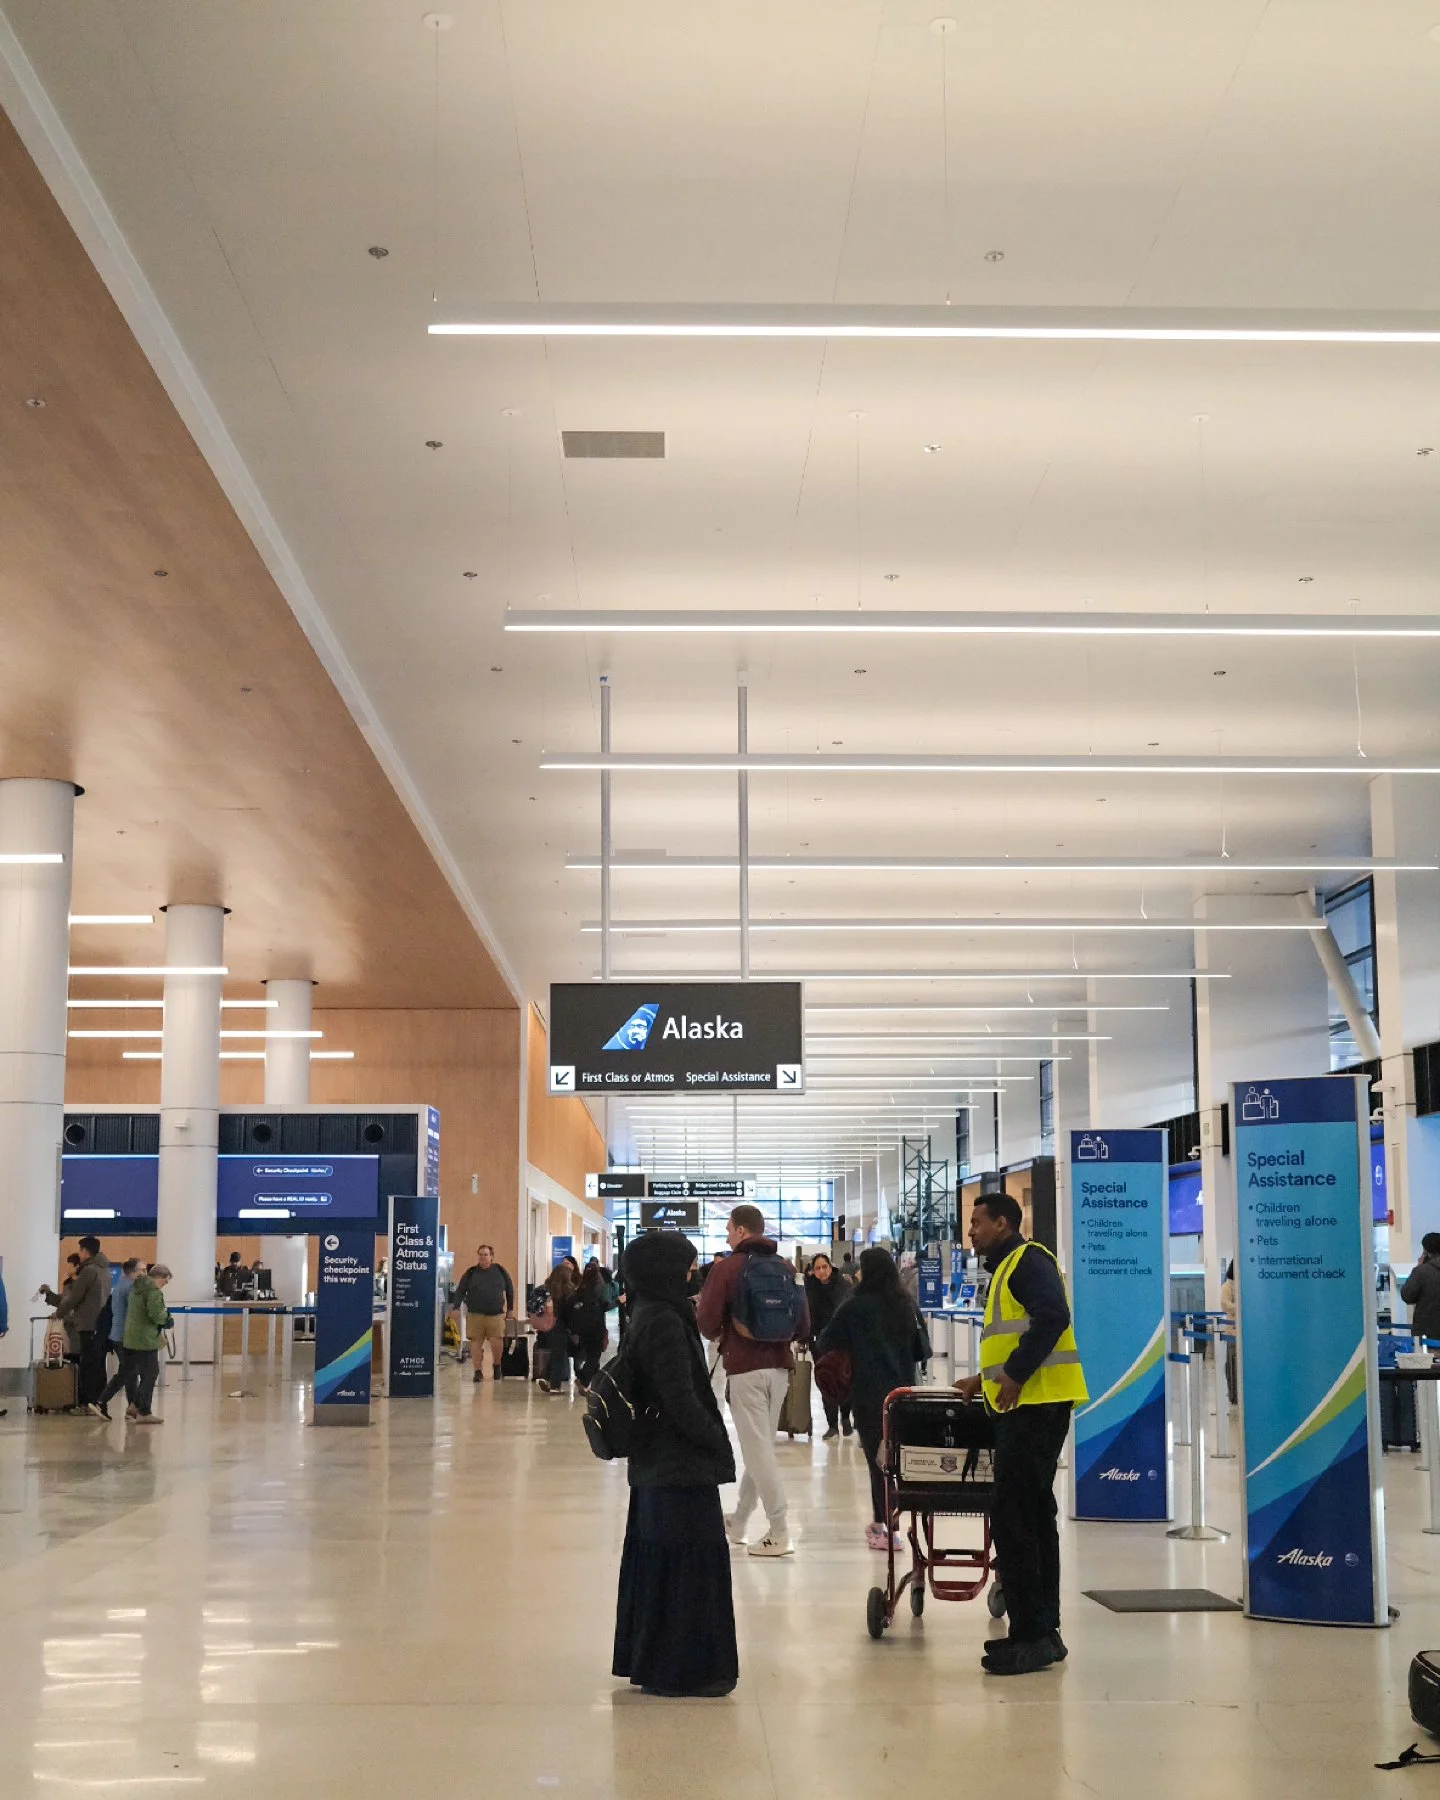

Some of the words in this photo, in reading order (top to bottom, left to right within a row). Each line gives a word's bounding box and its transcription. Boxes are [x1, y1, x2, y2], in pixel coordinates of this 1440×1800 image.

[662, 1015, 743, 1039] Alaska
[582, 1072, 602, 1083] First
[605, 1072, 629, 1083] Class
[631, 1074, 642, 1083] or
[643, 1072, 675, 1083] Atmos
[686, 1072, 719, 1084] Special
[721, 1071, 771, 1082] Assistance
[1247, 1150, 1305, 1170] Special
[1248, 1172, 1337, 1188] Assistance
[1081, 1181, 1127, 1195] Special
[1081, 1196, 1149, 1208] Assistance
[1255, 1202, 1301, 1213] Children
[666, 1209, 687, 1217] Alaska
[1087, 1219, 1123, 1228] Children
[1255, 1215, 1301, 1228] traveling
[1304, 1215, 1338, 1226] alone
[397, 1223, 420, 1234] First
[1087, 1228, 1123, 1239] traveling
[1125, 1228, 1148, 1237] alone
[396, 1235, 424, 1246] Class
[425, 1235, 434, 1246] &
[1256, 1235, 1280, 1246] Pets
[1088, 1242, 1106, 1251] Pets
[396, 1247, 429, 1258] Atmos
[324, 1255, 358, 1266] Security
[395, 1260, 428, 1270] Status
[1088, 1257, 1138, 1265] International
[1257, 1254, 1323, 1265] International
[324, 1265, 370, 1275] checkpoint
[1088, 1266, 1127, 1275] document
[1129, 1266, 1153, 1275] check
[1258, 1268, 1310, 1280] document
[1311, 1268, 1346, 1280] check
[324, 1275, 339, 1283] this
[340, 1277, 357, 1285] way
[399, 1357, 425, 1365] ATMOS
[1099, 1467, 1141, 1482] Alaska
[1277, 1548, 1334, 1568] Alaska
